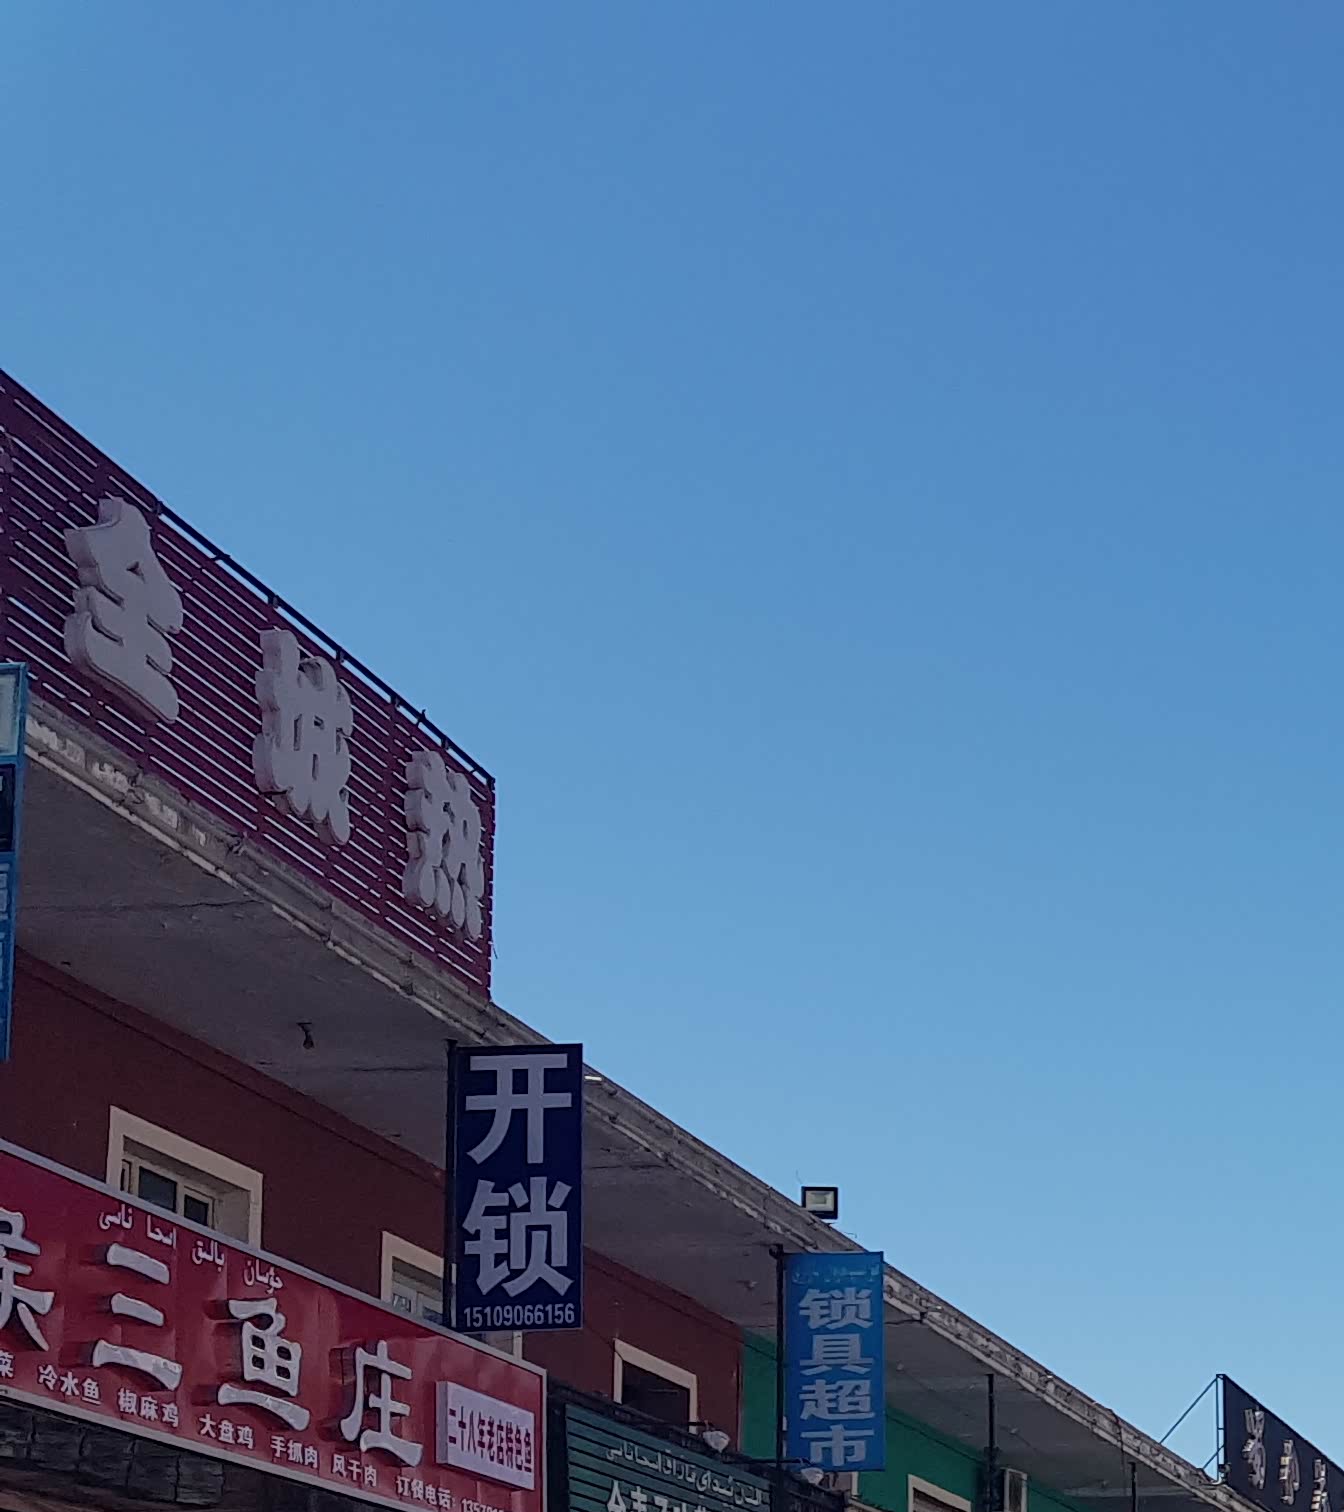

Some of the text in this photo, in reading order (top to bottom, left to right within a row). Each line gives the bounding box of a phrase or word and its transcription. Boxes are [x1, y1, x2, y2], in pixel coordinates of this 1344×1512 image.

[462, 1052, 573, 1297] 开锁
[463, 1302, 575, 1327] 15109066156
[799, 1287, 876, 1468] 锁具超市
[38, 1364, 101, 1406] 冷水鱼
[117, 1388, 180, 1428] 椒麻鸡
[199, 1414, 256, 1450] 大盘鸡
[270, 1436, 319, 1469] 手抓肉
[330, 1454, 378, 1488] 风干肉
